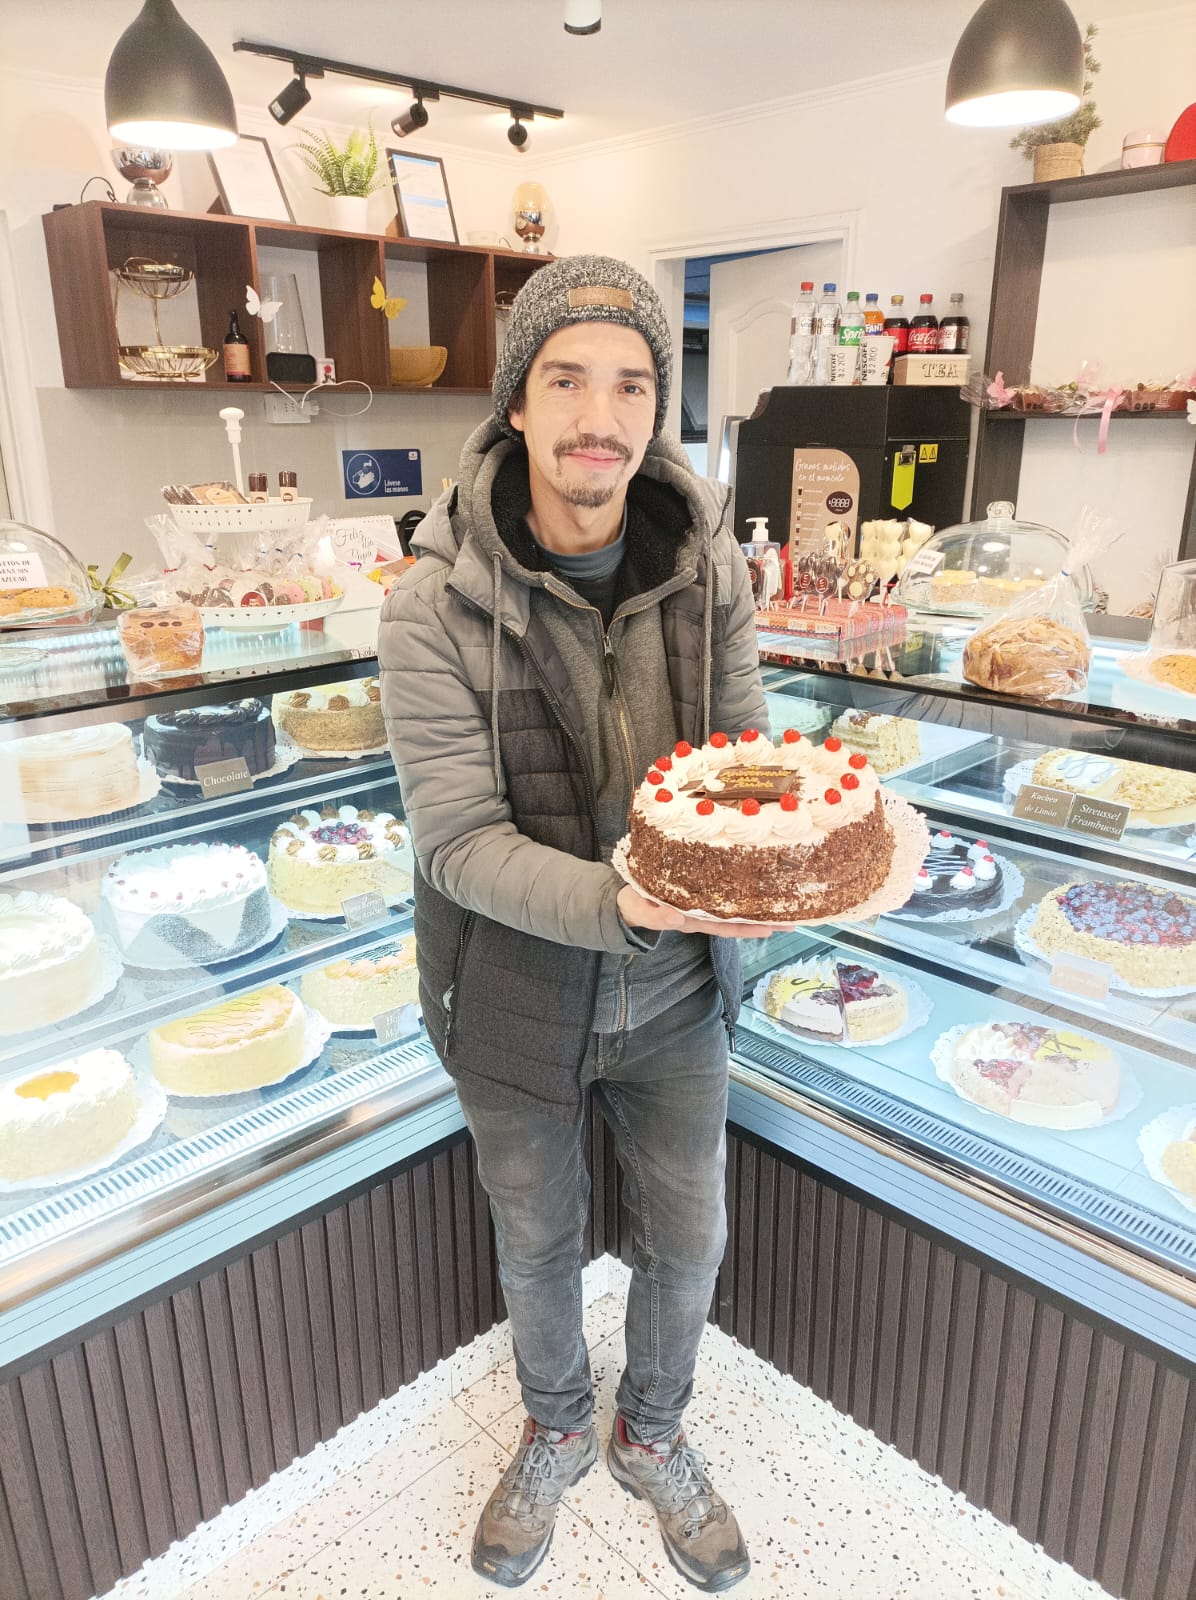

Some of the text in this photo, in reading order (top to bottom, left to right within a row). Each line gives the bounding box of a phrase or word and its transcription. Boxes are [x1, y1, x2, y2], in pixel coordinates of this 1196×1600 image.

[922, 362, 959, 378] TEA
[203, 771, 248, 787] Chocolate
[1031, 791, 1058, 804] Kuchen
[1024, 804, 1034, 813] de
[1080, 803, 1122, 821] Streussel
[1071, 814, 1122, 835] Frambuesa
